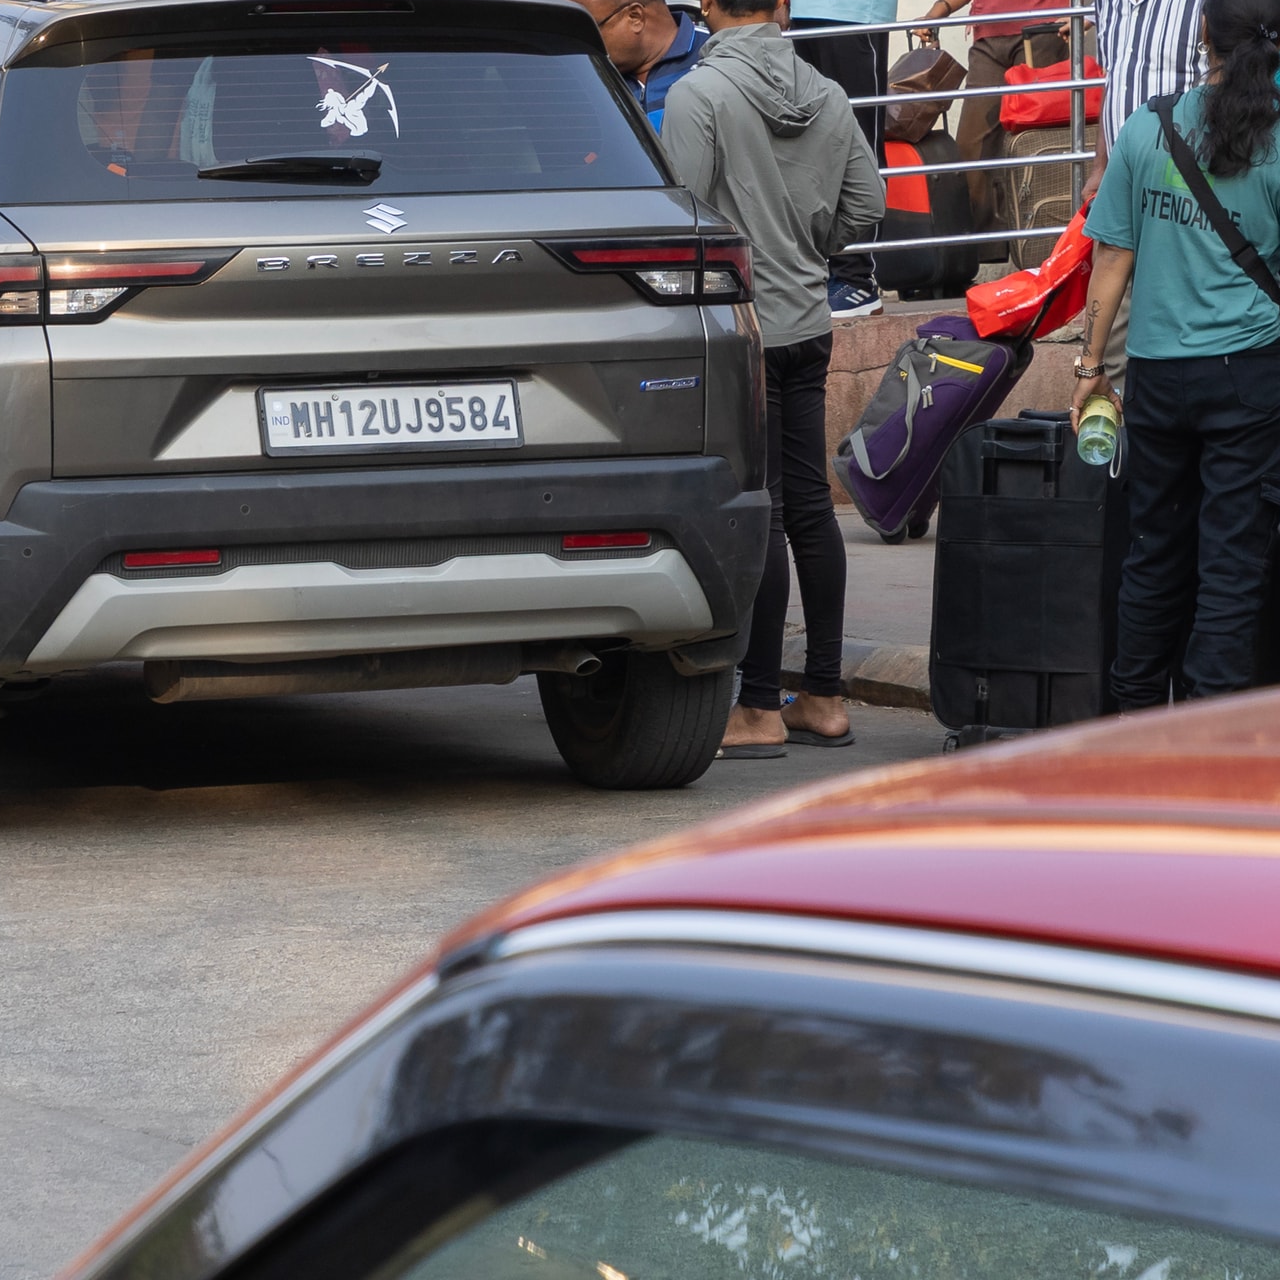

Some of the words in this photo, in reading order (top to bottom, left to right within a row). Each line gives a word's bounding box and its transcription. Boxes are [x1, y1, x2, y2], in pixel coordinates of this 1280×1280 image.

[256, 249, 526, 272] BREZZA
[272, 415, 290, 426] IND
[290, 394, 511, 438] MH12UJ9584
